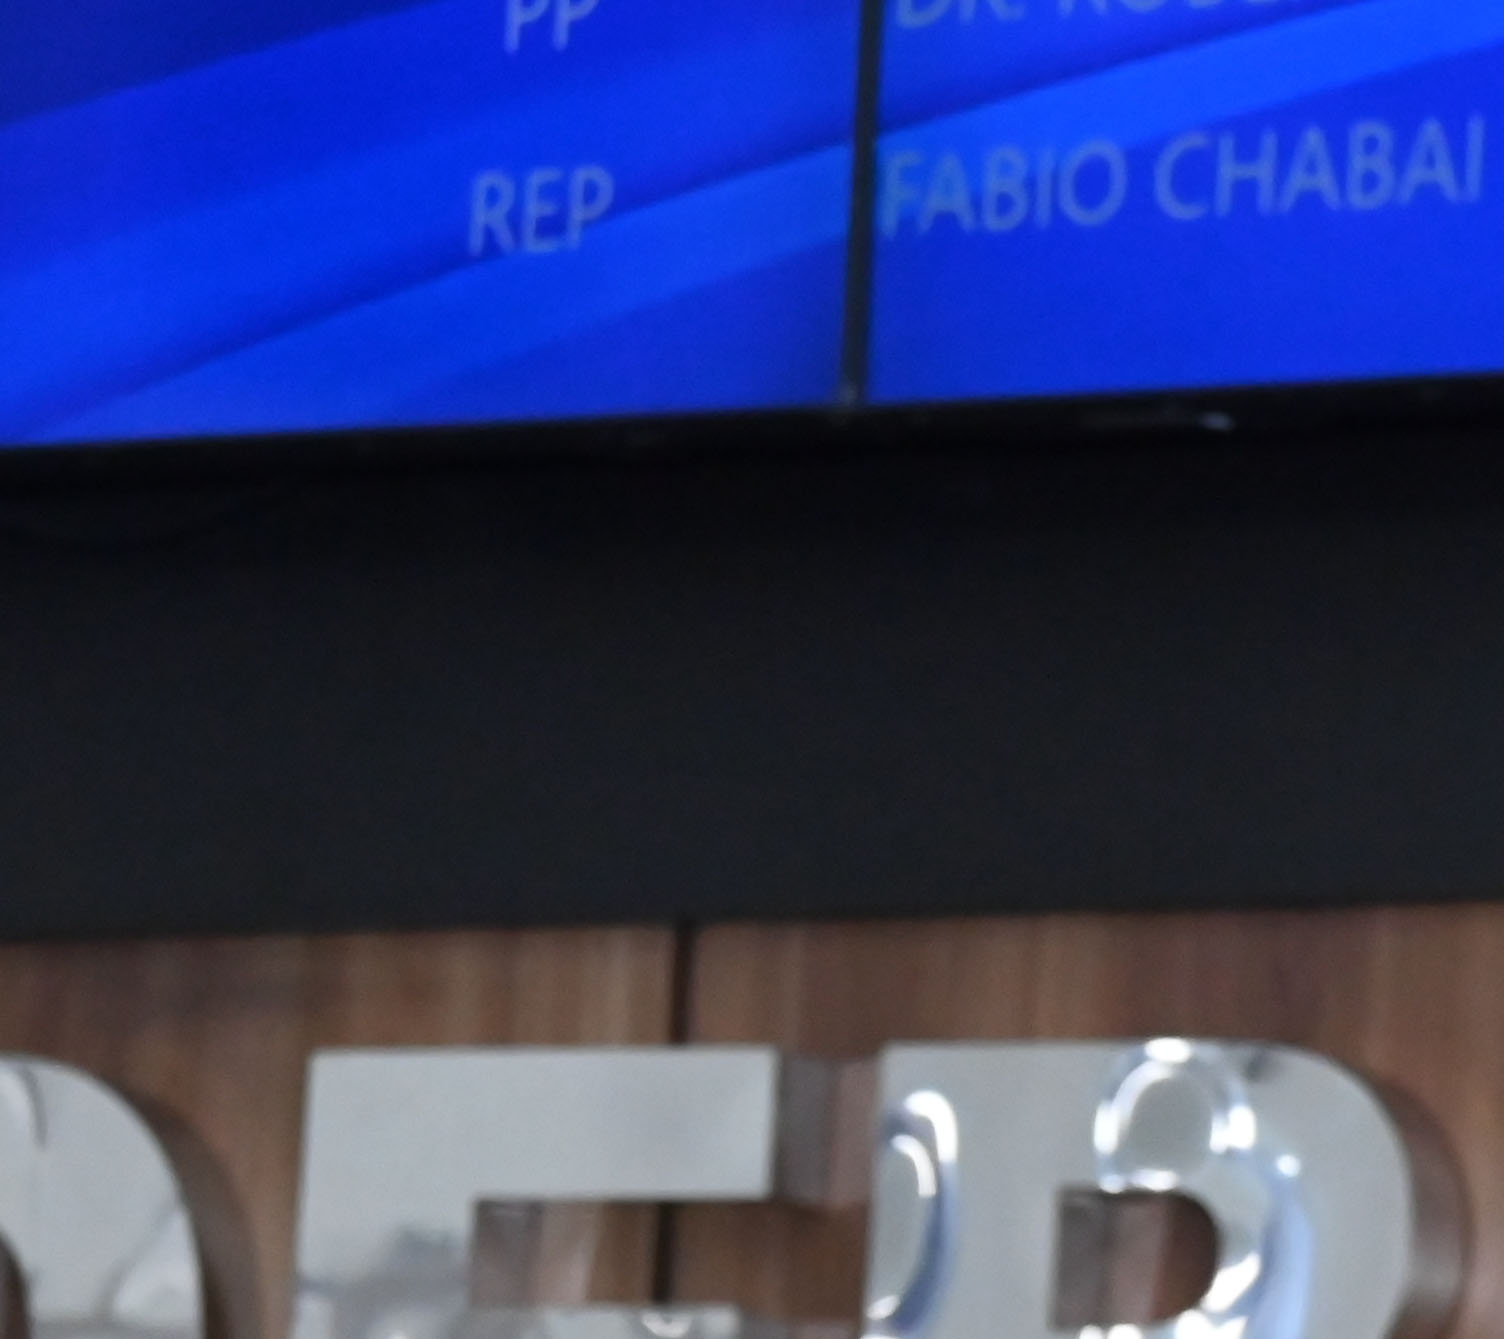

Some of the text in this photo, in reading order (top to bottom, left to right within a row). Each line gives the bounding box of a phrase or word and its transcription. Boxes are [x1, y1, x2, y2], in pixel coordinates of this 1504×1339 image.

[468, 163, 616, 258] REP
[878, 113, 1486, 240] FABIO CHABAI
